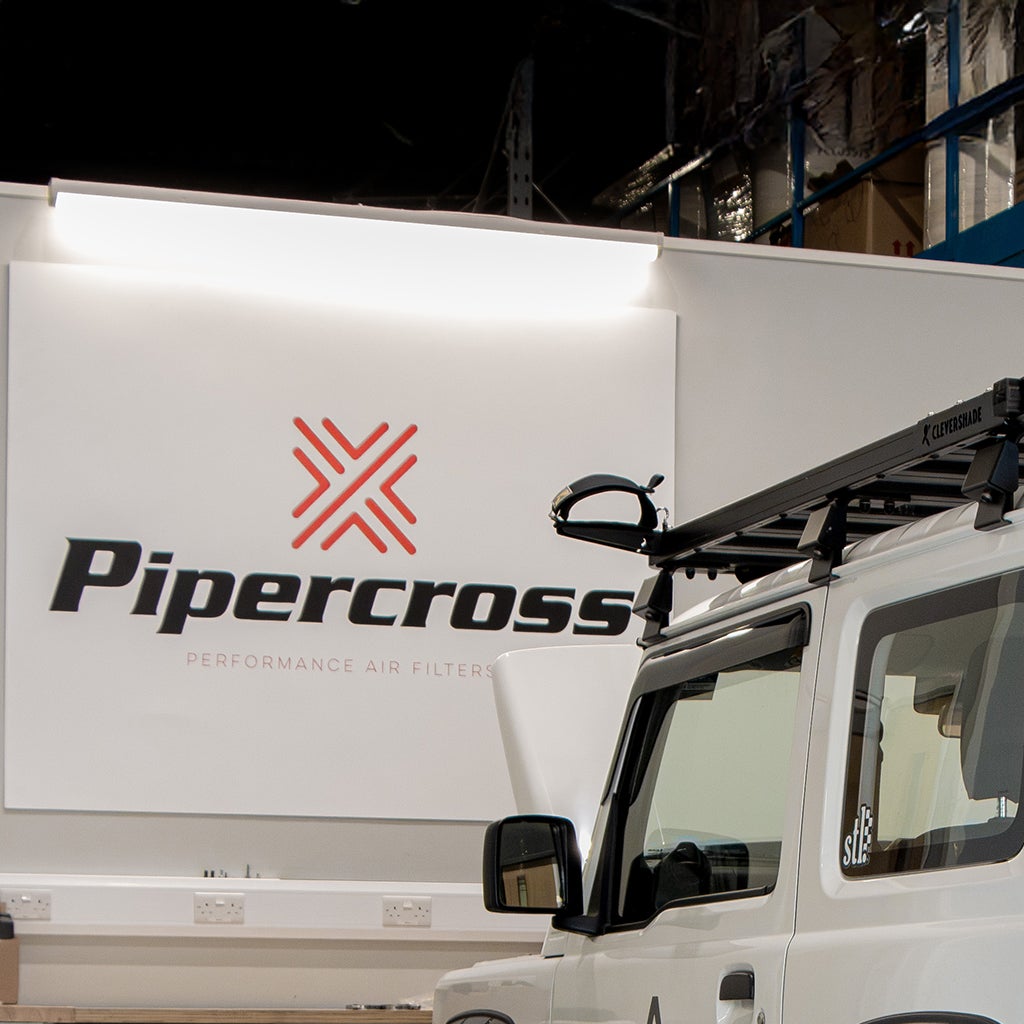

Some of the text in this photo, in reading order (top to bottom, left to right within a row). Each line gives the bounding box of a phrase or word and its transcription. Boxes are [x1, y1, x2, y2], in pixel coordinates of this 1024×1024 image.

[931, 406, 983, 441] CLEVERSHADE
[49, 537, 636, 635] Pipercross
[186, 651, 354, 673] PERFORMANCE
[365, 659, 400, 675] AIR
